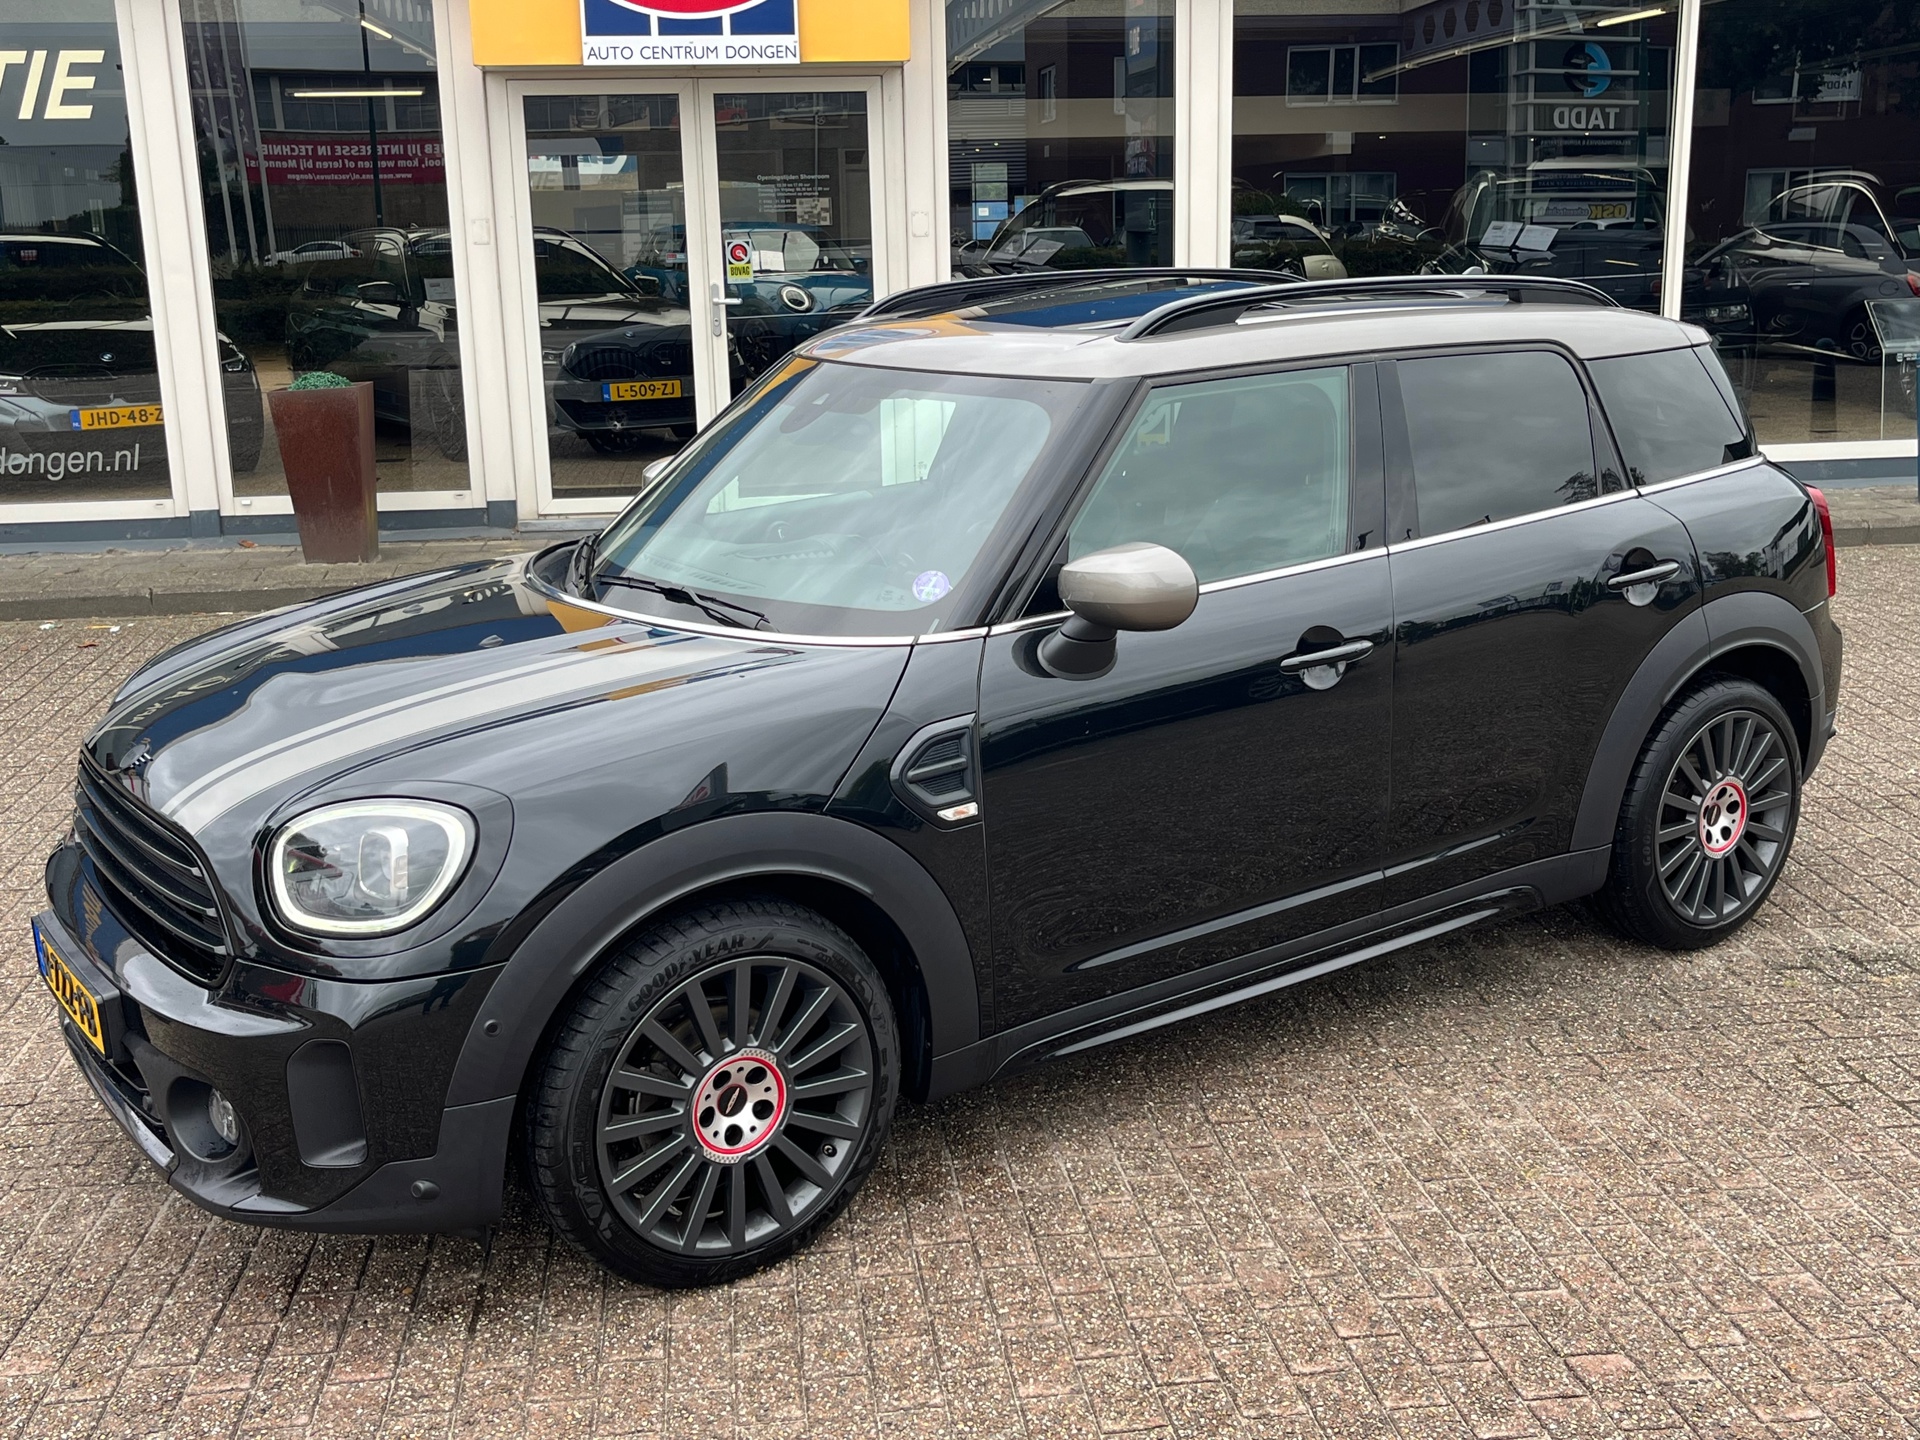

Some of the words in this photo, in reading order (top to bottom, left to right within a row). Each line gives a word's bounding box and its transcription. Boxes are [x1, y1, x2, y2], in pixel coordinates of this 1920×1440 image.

[587, 46, 633, 60] AUTO
[640, 46, 719, 60] CENTRUM
[725, 45, 797, 59] DONGEN
[730, 265, 750, 276] BOVAG
[616, 382, 675, 399] L-509-ZJ
